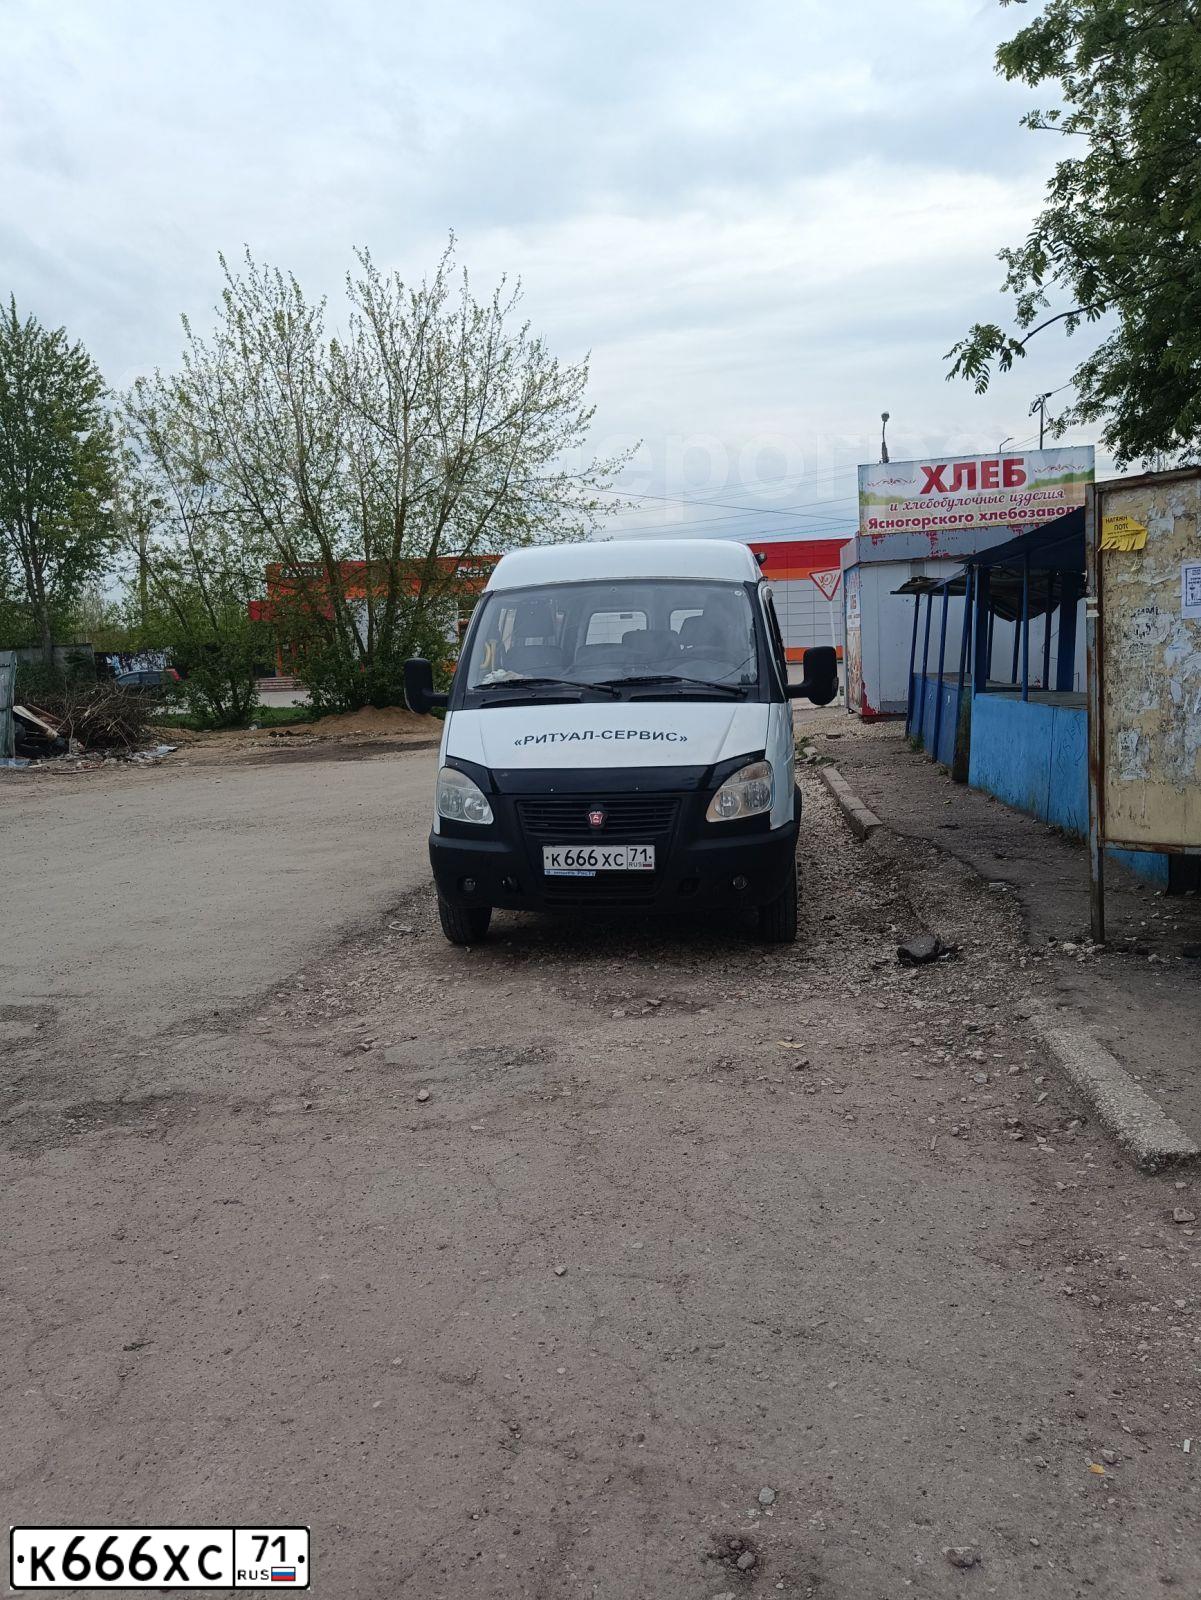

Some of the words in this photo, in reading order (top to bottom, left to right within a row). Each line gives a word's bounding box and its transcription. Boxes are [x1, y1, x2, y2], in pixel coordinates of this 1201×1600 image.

[919, 457, 1028, 495] ХЛЕБ
[889, 501, 899, 512] и
[902, 492, 1006, 513] хлебобулочные
[1008, 488, 1065, 508] изделия
[868, 510, 975, 530] Ясногорского
[978, 505, 1083, 525] хлебозавод
[514, 730, 688, 747] «РИТУАЛ-СЕРВИС»
[629, 848, 648, 862] 71
